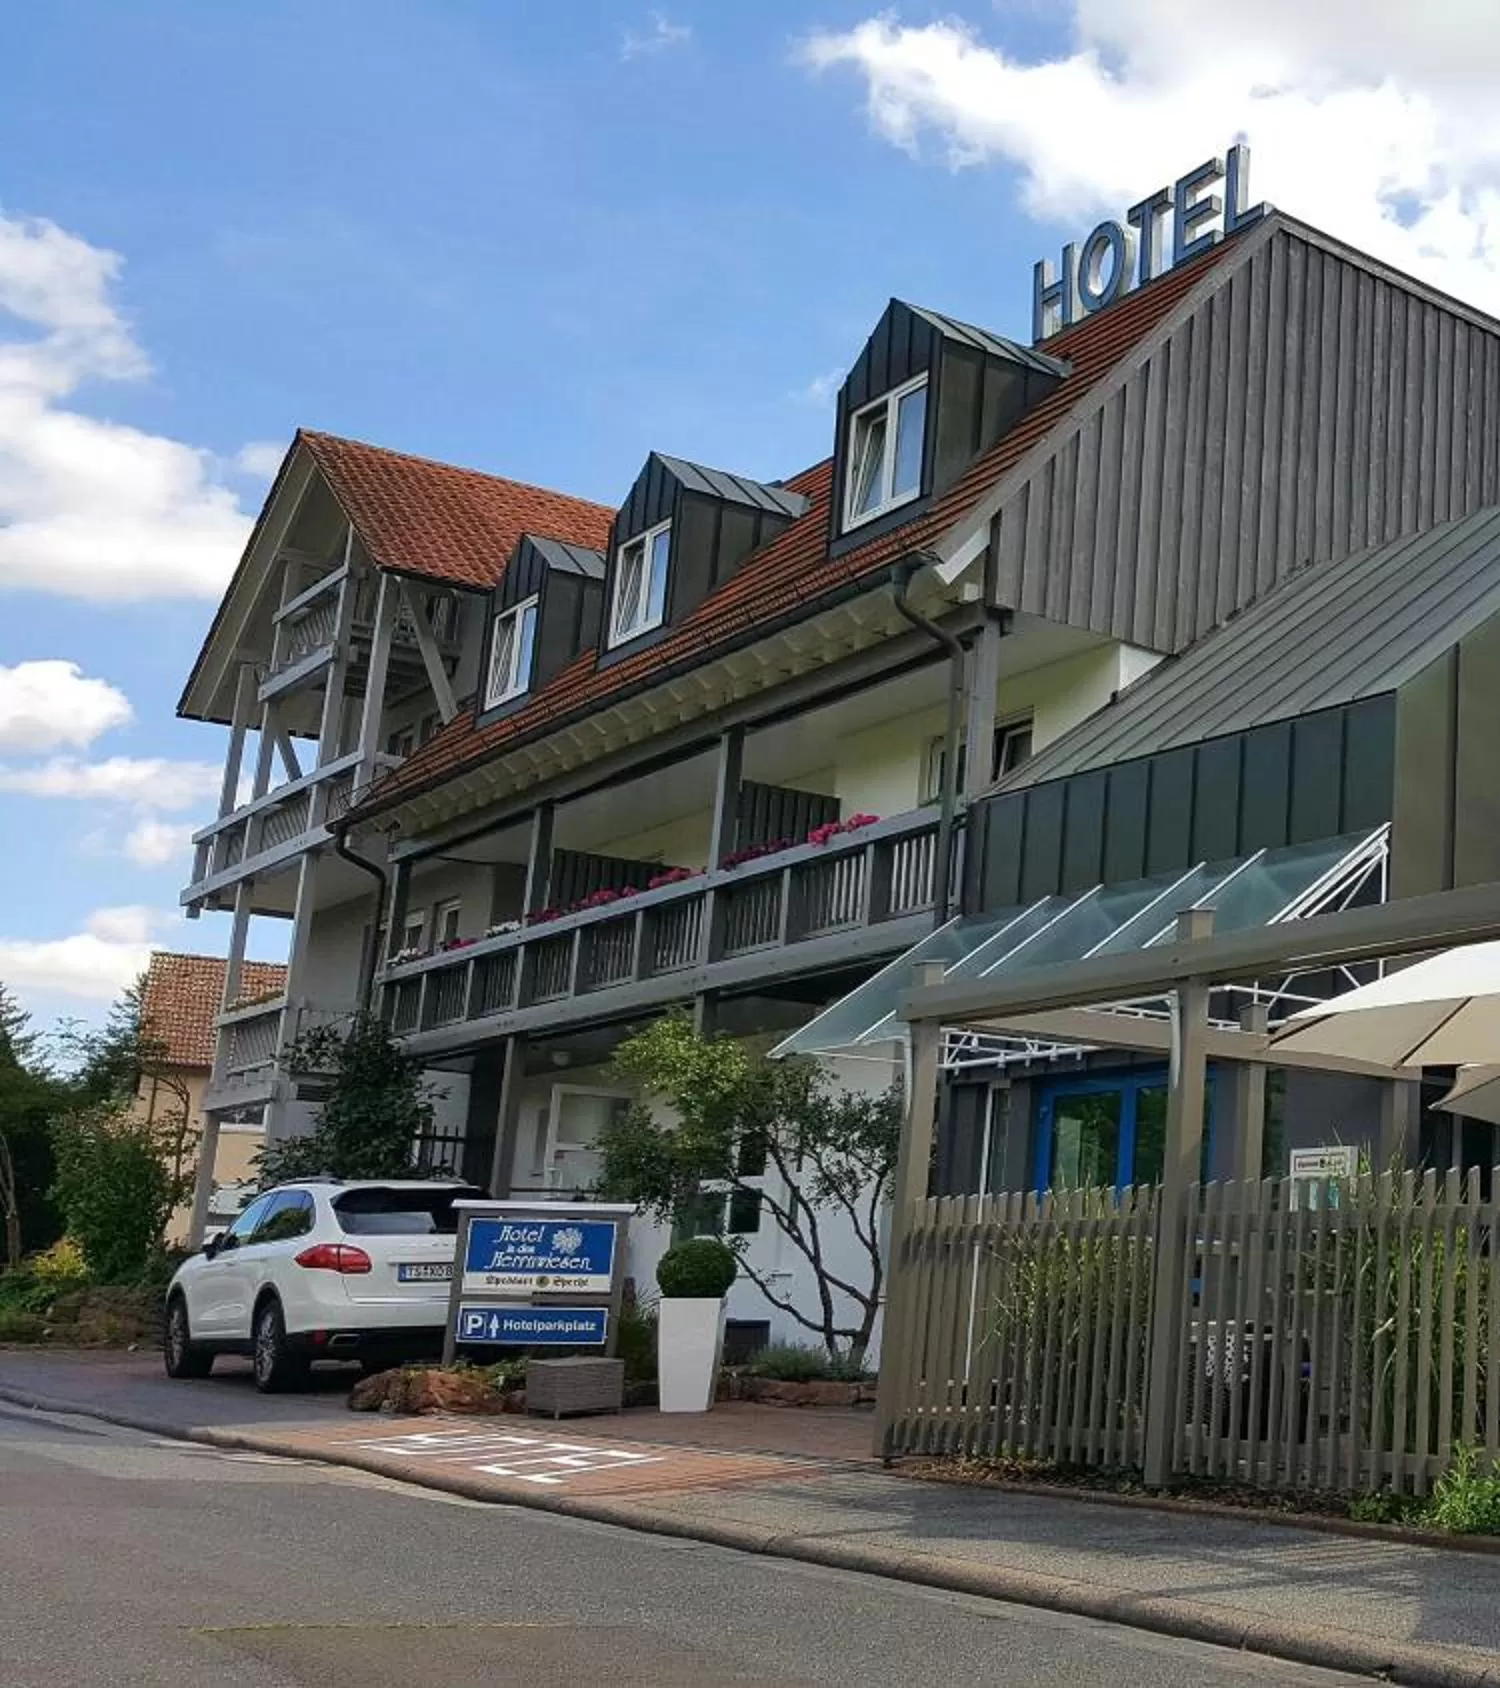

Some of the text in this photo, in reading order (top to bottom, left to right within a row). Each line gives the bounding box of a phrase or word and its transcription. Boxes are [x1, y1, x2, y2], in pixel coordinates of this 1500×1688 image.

[1031, 143, 1275, 344] HOTEL
[492, 1225, 545, 1243] Hotel
[466, 1315, 597, 1334] P Hotelparkplatz
[328, 1429, 665, 1483] HOTEL
